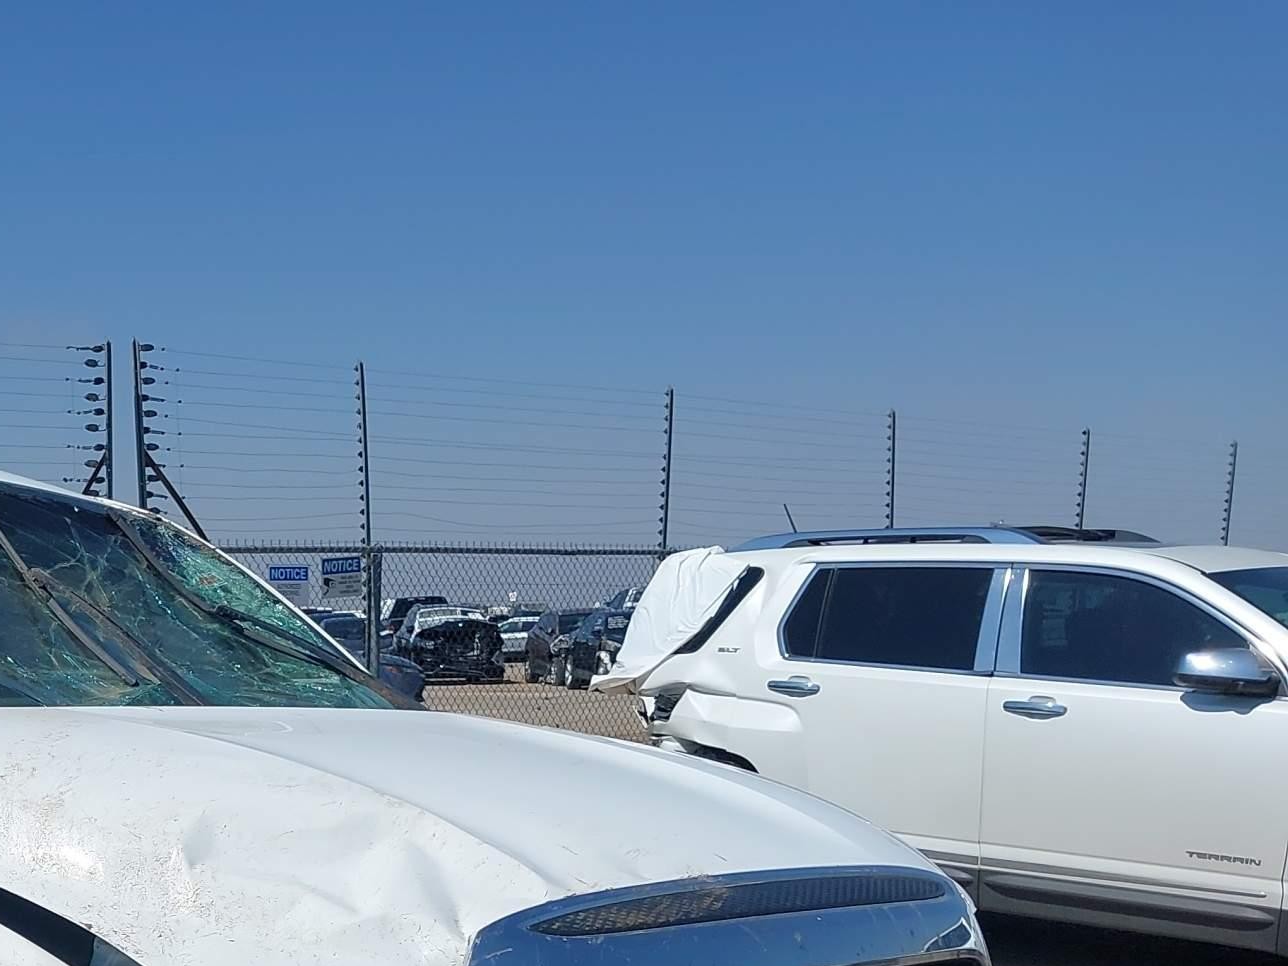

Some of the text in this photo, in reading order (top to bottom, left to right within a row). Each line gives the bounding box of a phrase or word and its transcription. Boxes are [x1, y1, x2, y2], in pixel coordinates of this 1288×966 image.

[323, 559, 359, 572] NOTICE
[271, 568, 307, 580] NOTICE
[1185, 850, 1262, 866] TERRAIN
